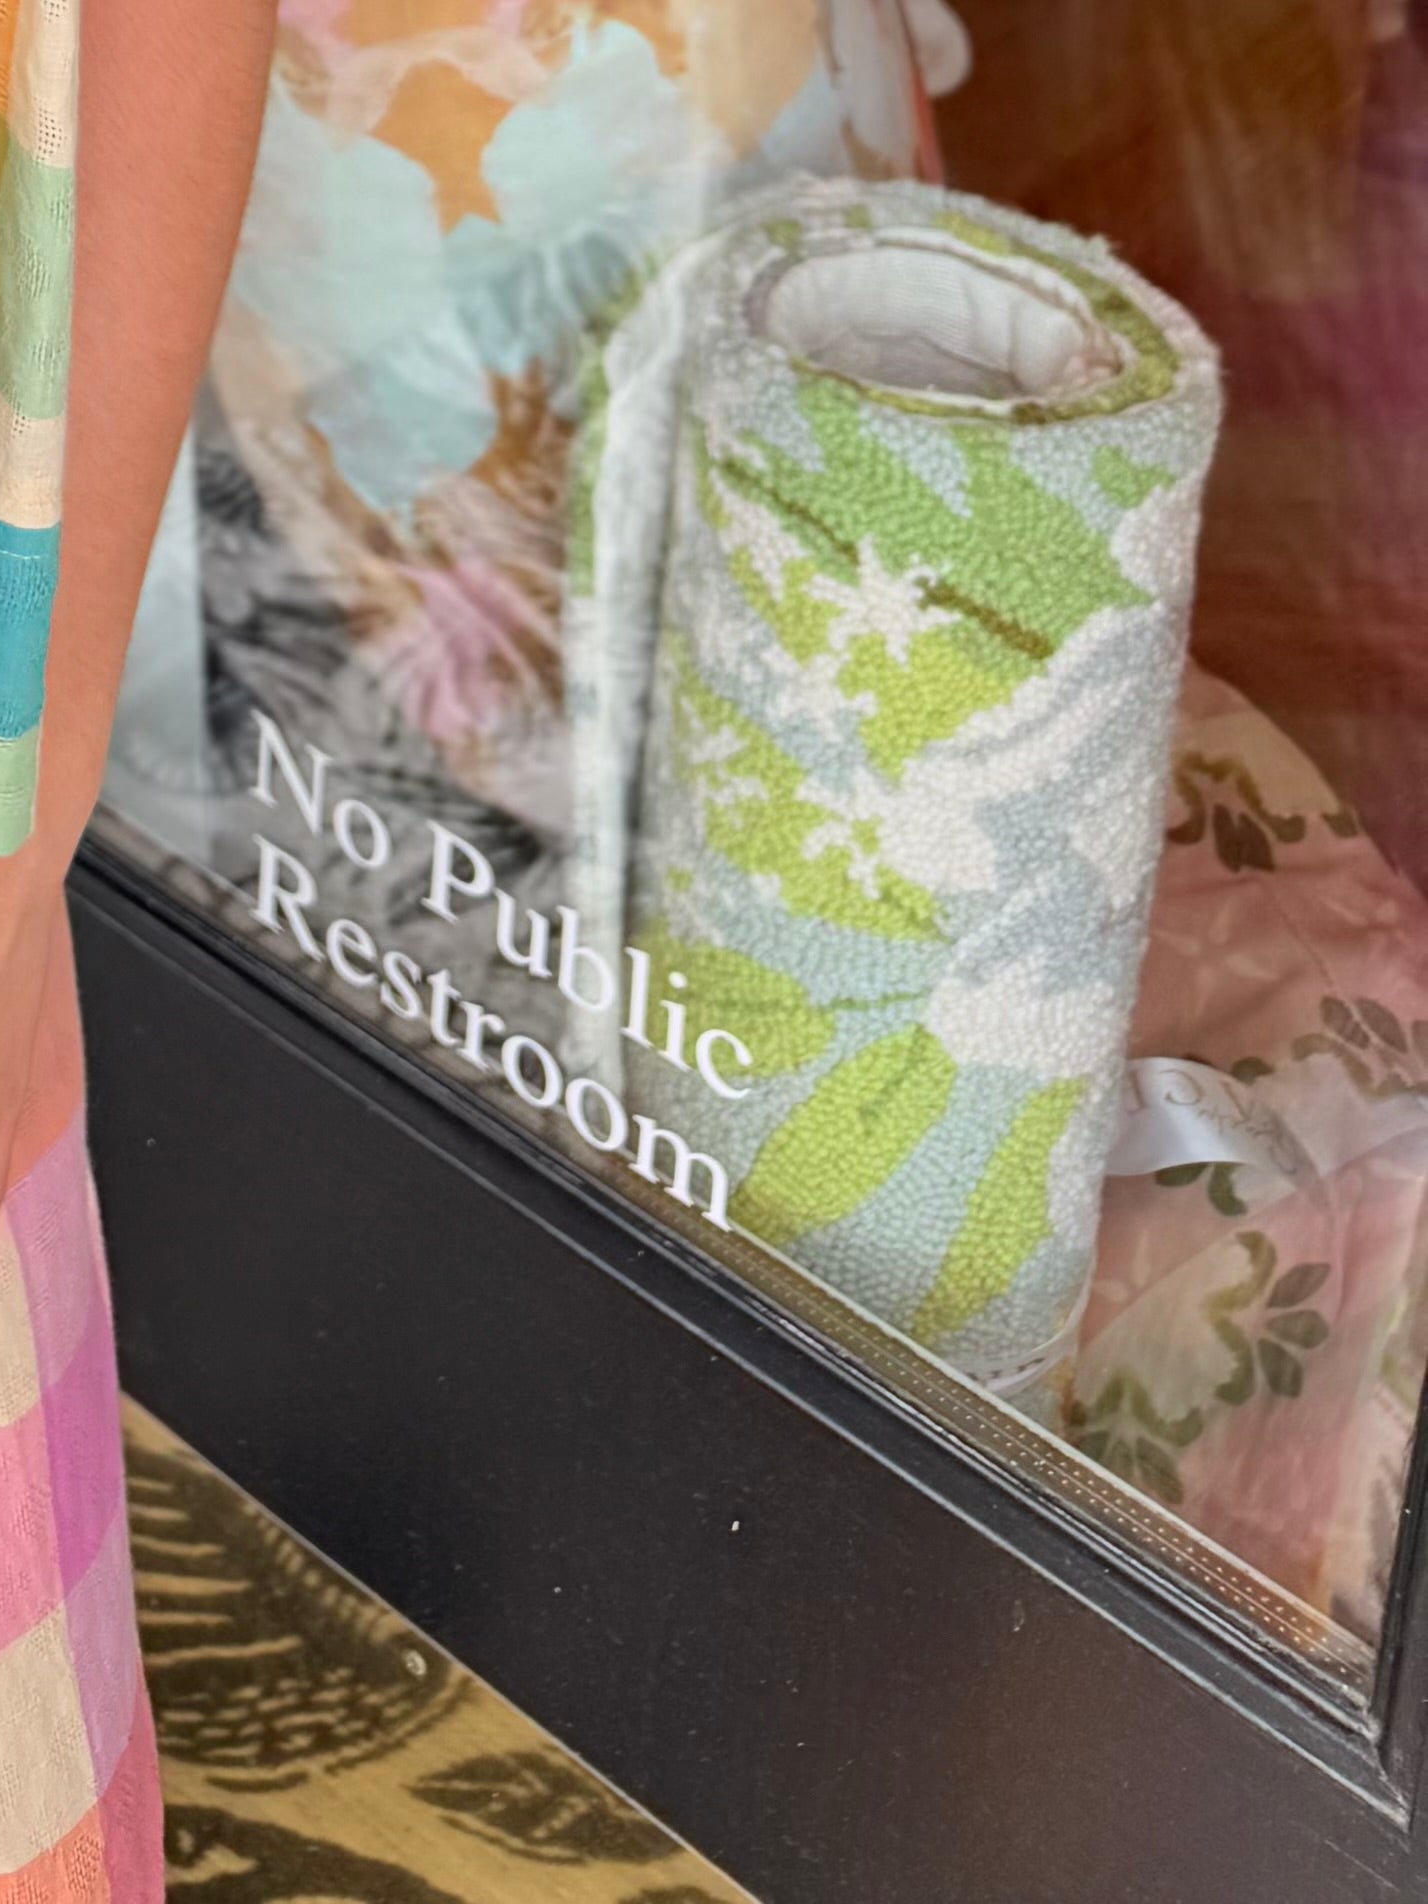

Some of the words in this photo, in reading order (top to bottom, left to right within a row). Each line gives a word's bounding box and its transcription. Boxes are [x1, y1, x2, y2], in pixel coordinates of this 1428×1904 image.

[251, 835, 732, 1231] Restroom
[252, 710, 390, 870] No
[423, 821, 752, 1100] Public
